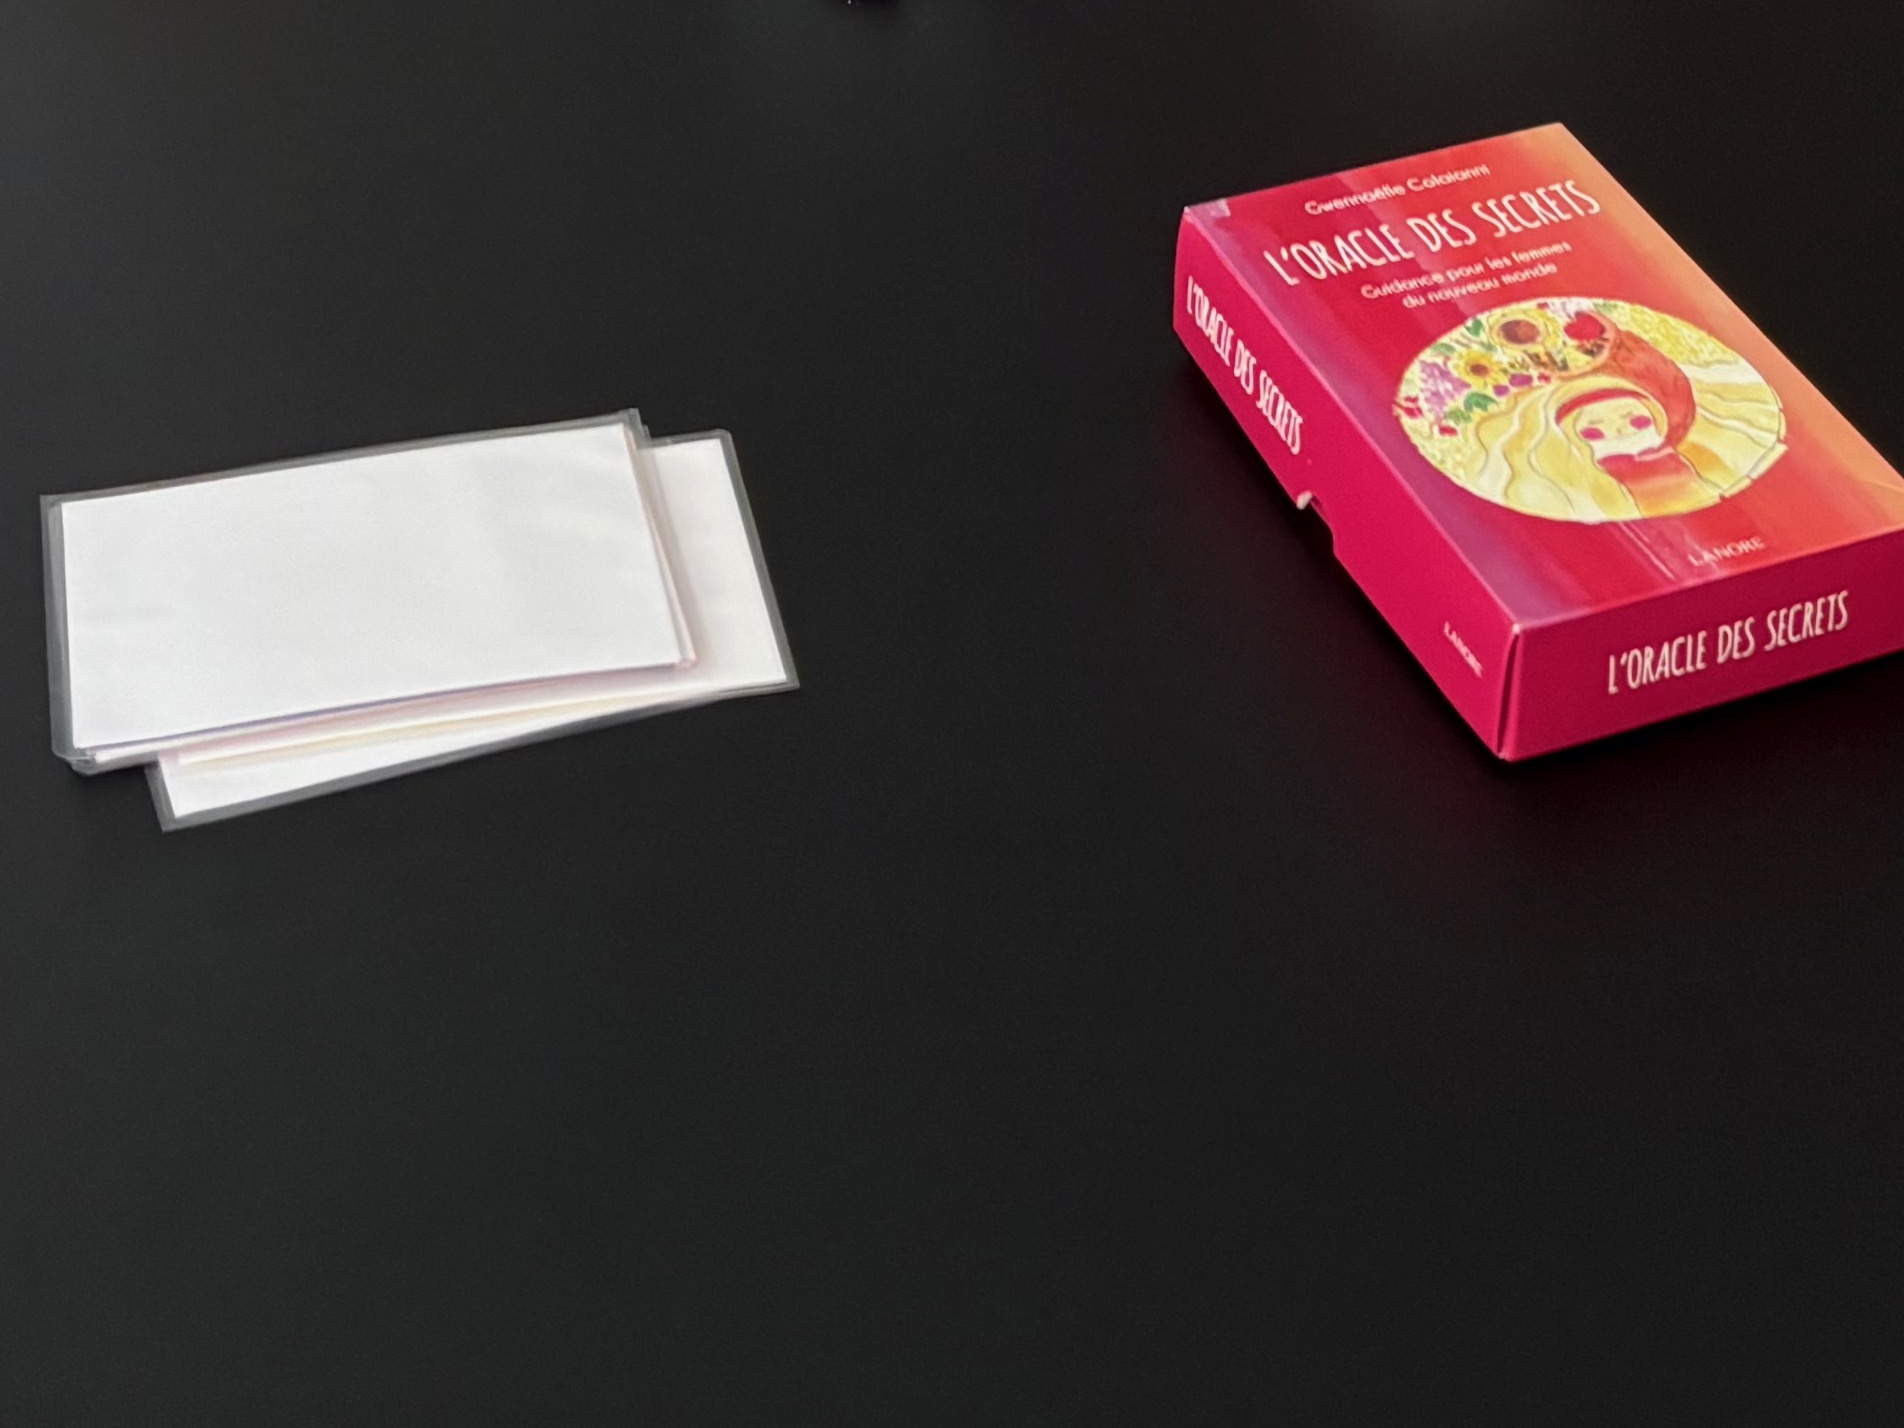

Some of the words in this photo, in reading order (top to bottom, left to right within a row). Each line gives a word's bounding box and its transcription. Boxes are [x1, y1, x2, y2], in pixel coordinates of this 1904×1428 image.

[1405, 209, 1477, 253] DES
[1471, 179, 1601, 238] SECRETS
[1360, 272, 1445, 299] Guidance
[1446, 262, 1485, 283] pour
[1484, 256, 1513, 271] les
[1511, 240, 1572, 265] femmes
[1402, 294, 1426, 309] du
[1427, 278, 1500, 304] nouveau
[1501, 262, 1558, 286] monde
[1233, 338, 1256, 395] DES
[1256, 369, 1303, 455] SECRETS
[1687, 535, 1766, 568] LANORE
[1716, 616, 1756, 664] DES
[1764, 589, 1849, 652] SECRETS
